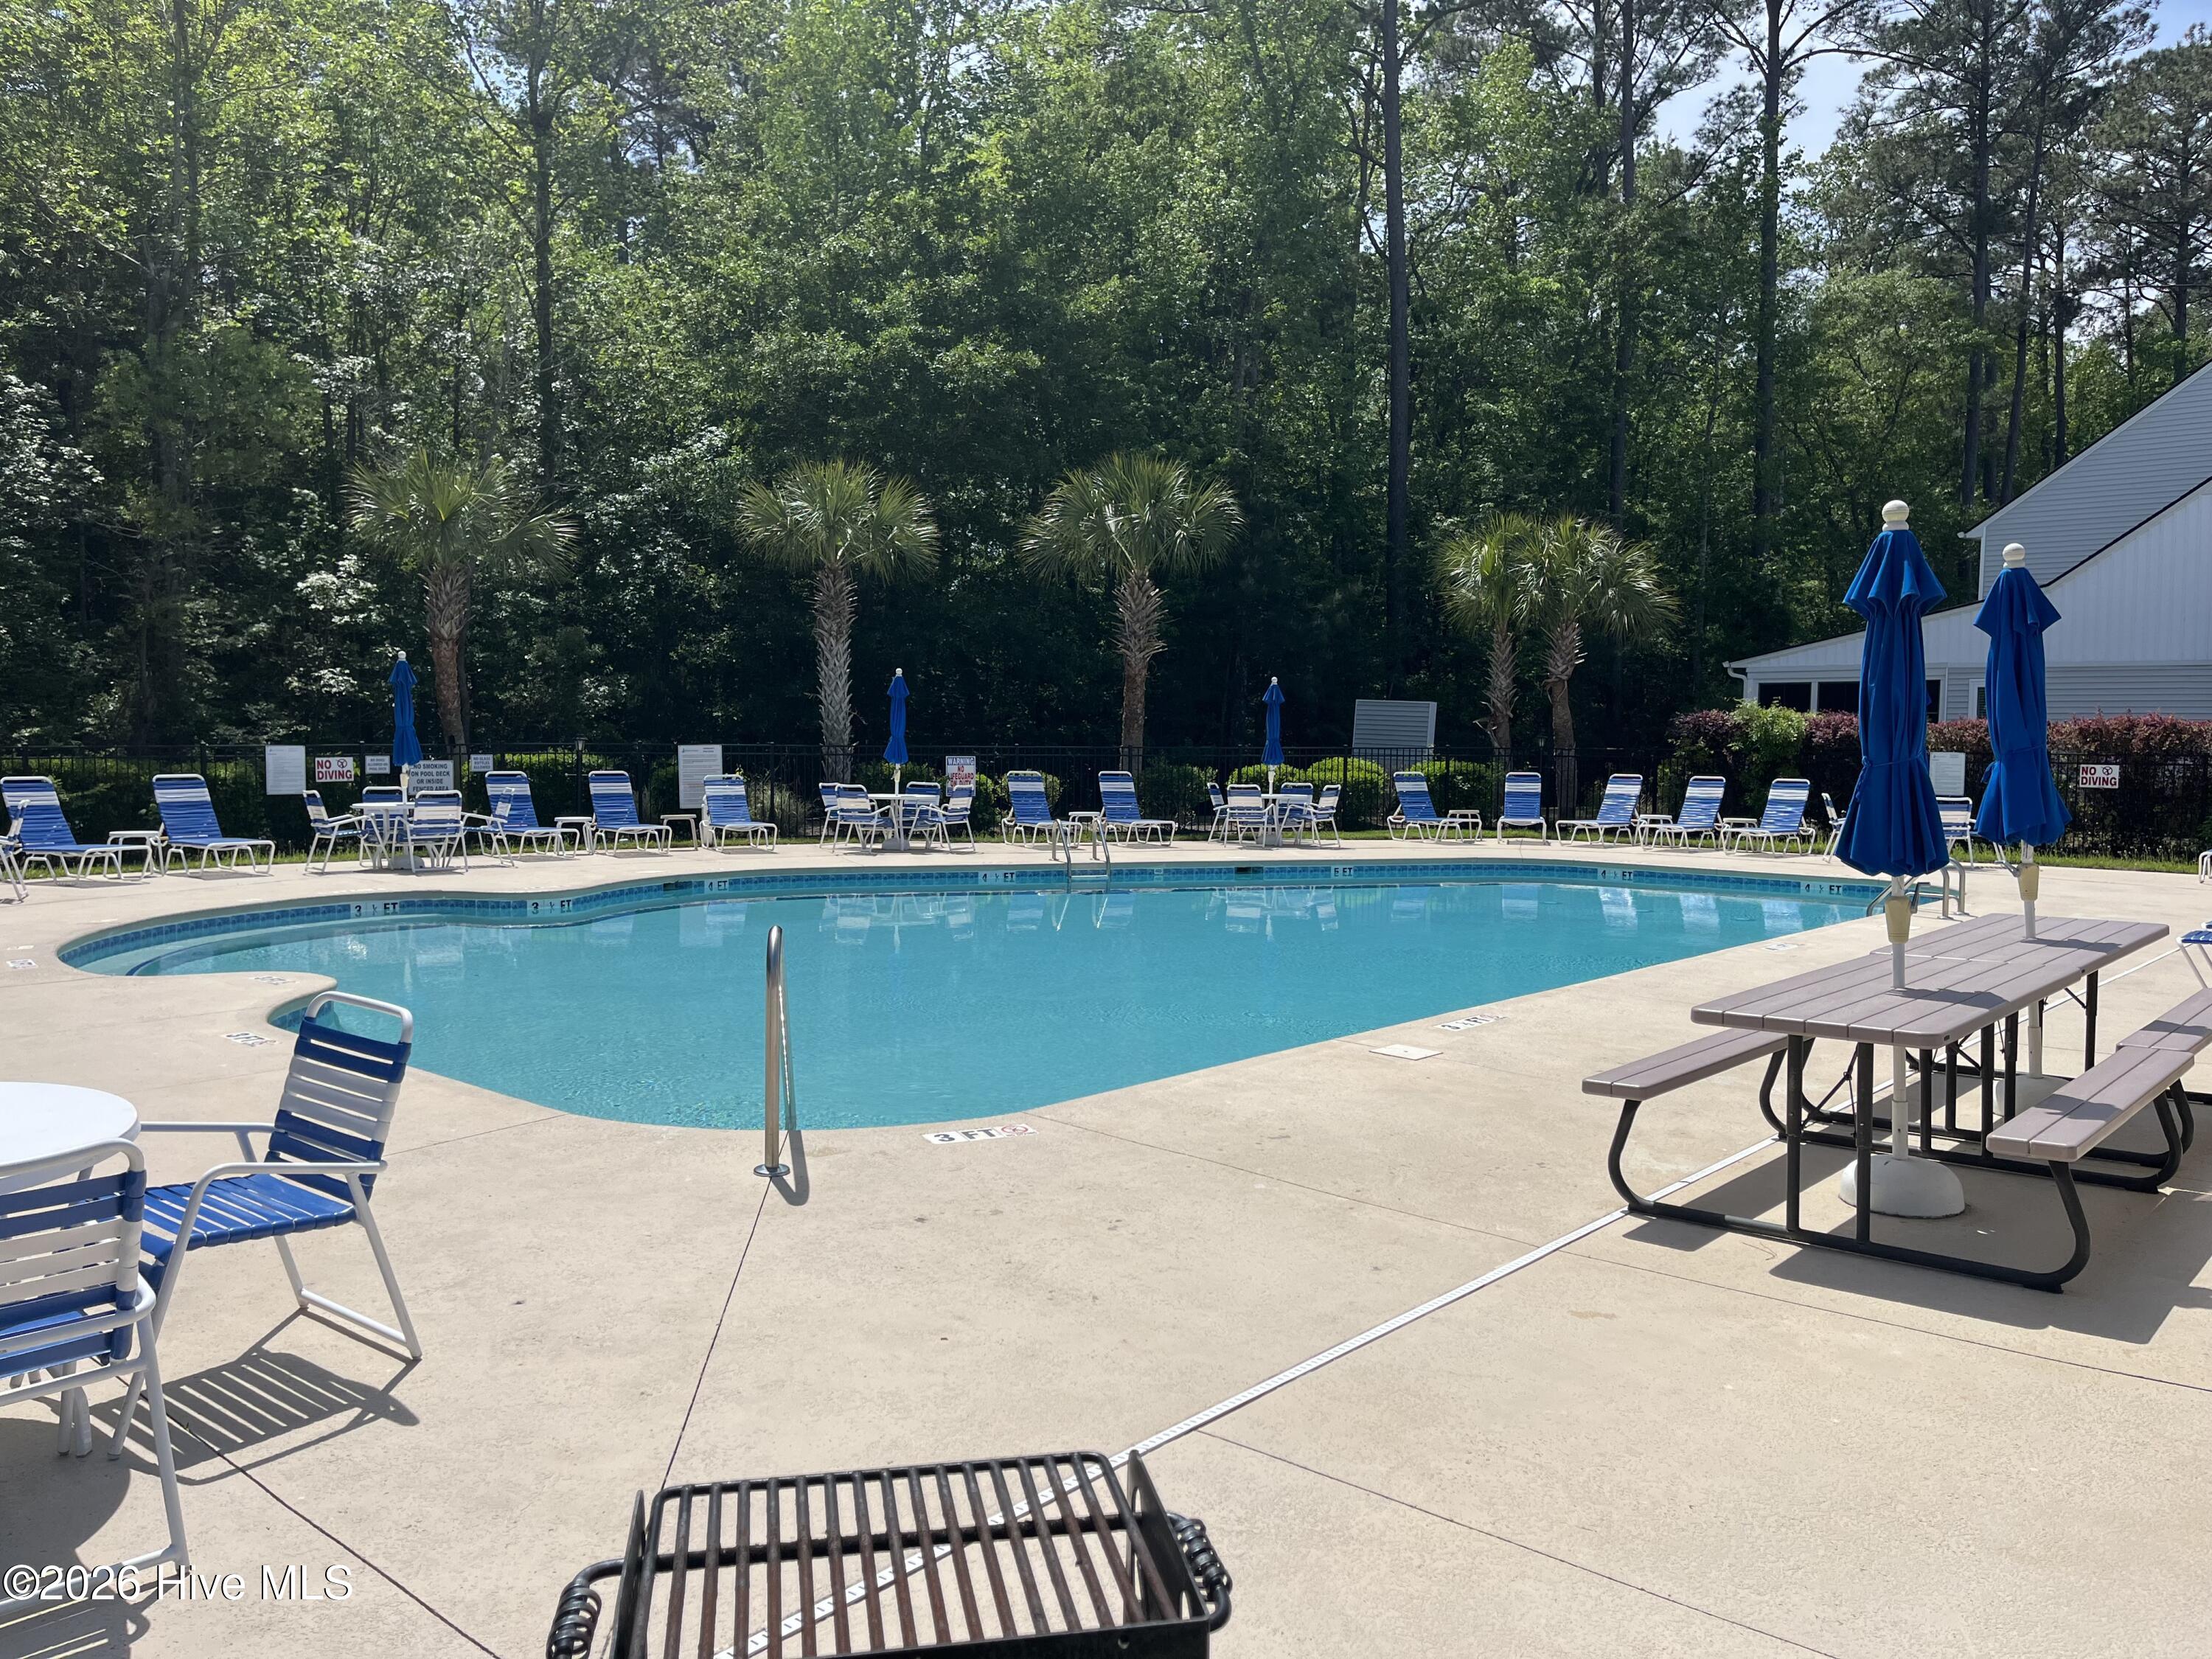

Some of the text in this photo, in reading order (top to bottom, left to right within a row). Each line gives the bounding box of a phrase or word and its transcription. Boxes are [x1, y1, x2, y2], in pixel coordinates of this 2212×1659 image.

[317, 759, 332, 769] NO
[947, 757, 974, 765] WARNING
[317, 770, 353, 780] DIVING
[2081, 766, 2096, 776] NO
[2081, 776, 2118, 786] DIVING
[933, 1133, 956, 1142] 3
[961, 1129, 995, 1140] FT
